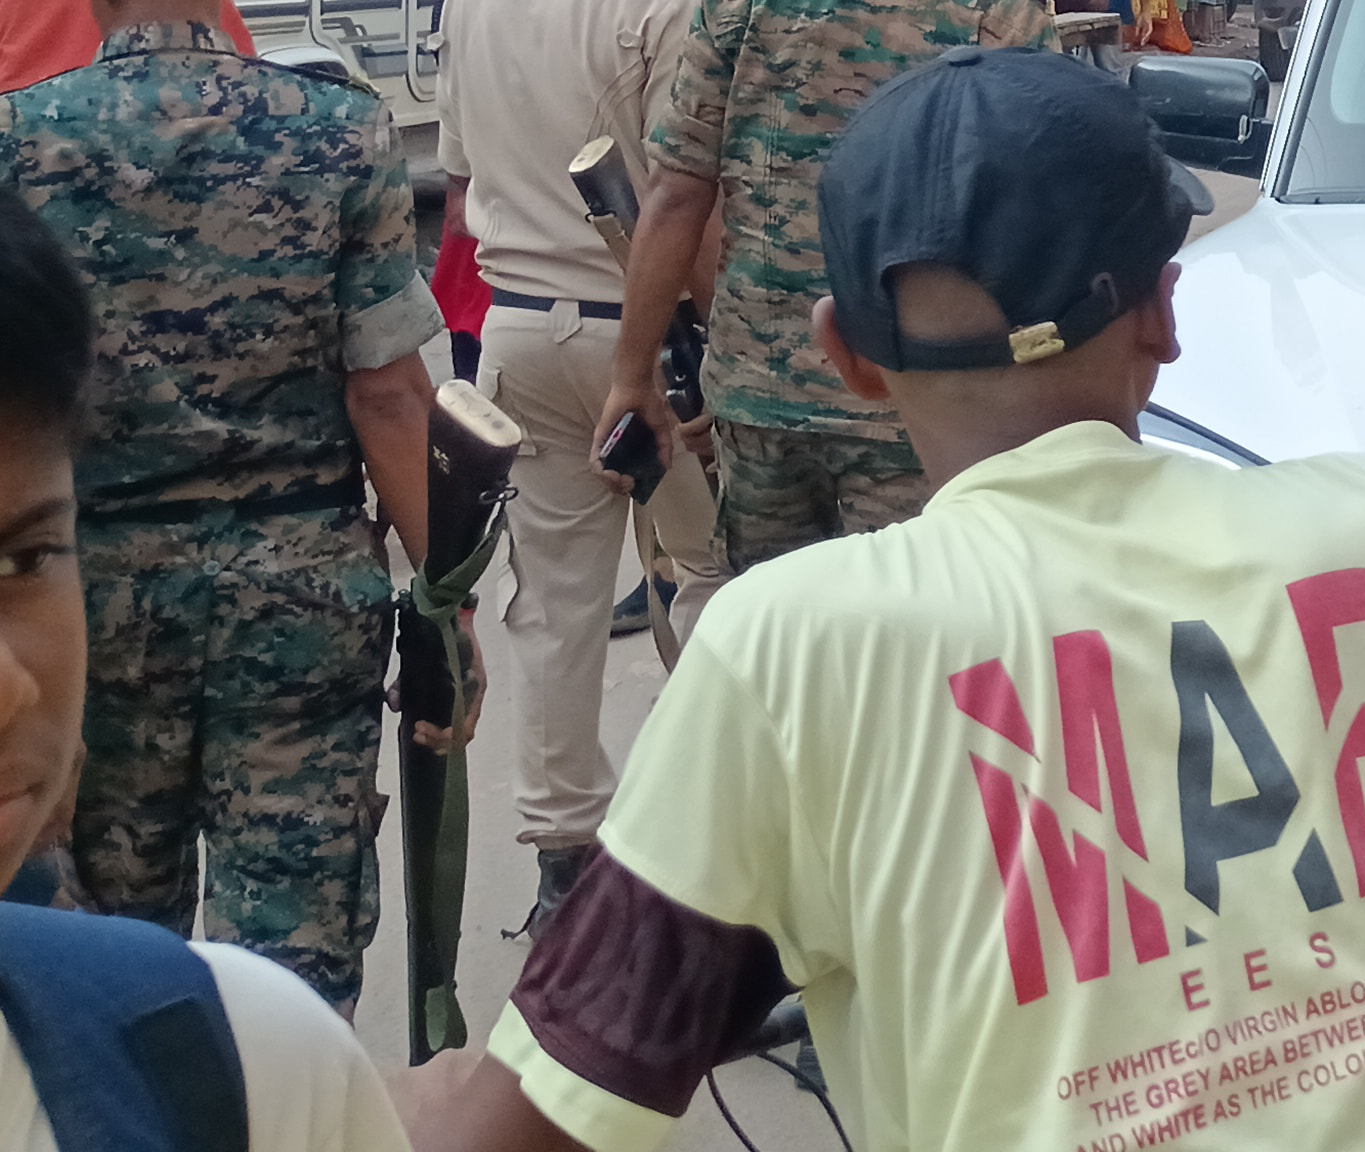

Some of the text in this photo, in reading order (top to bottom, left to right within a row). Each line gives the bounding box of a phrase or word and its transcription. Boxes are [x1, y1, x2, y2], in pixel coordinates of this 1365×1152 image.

[1057, 1065, 1100, 1101] OFF
[1224, 1001, 1299, 1046] VIRGIN
[1089, 1090, 1140, 1127] THE
[1145, 1066, 1211, 1109] GREY
[1218, 1046, 1278, 1087] AREA
[1131, 1103, 1208, 1149] WHITE
[1213, 1093, 1242, 1123] AS
[1246, 1076, 1293, 1110] THE
